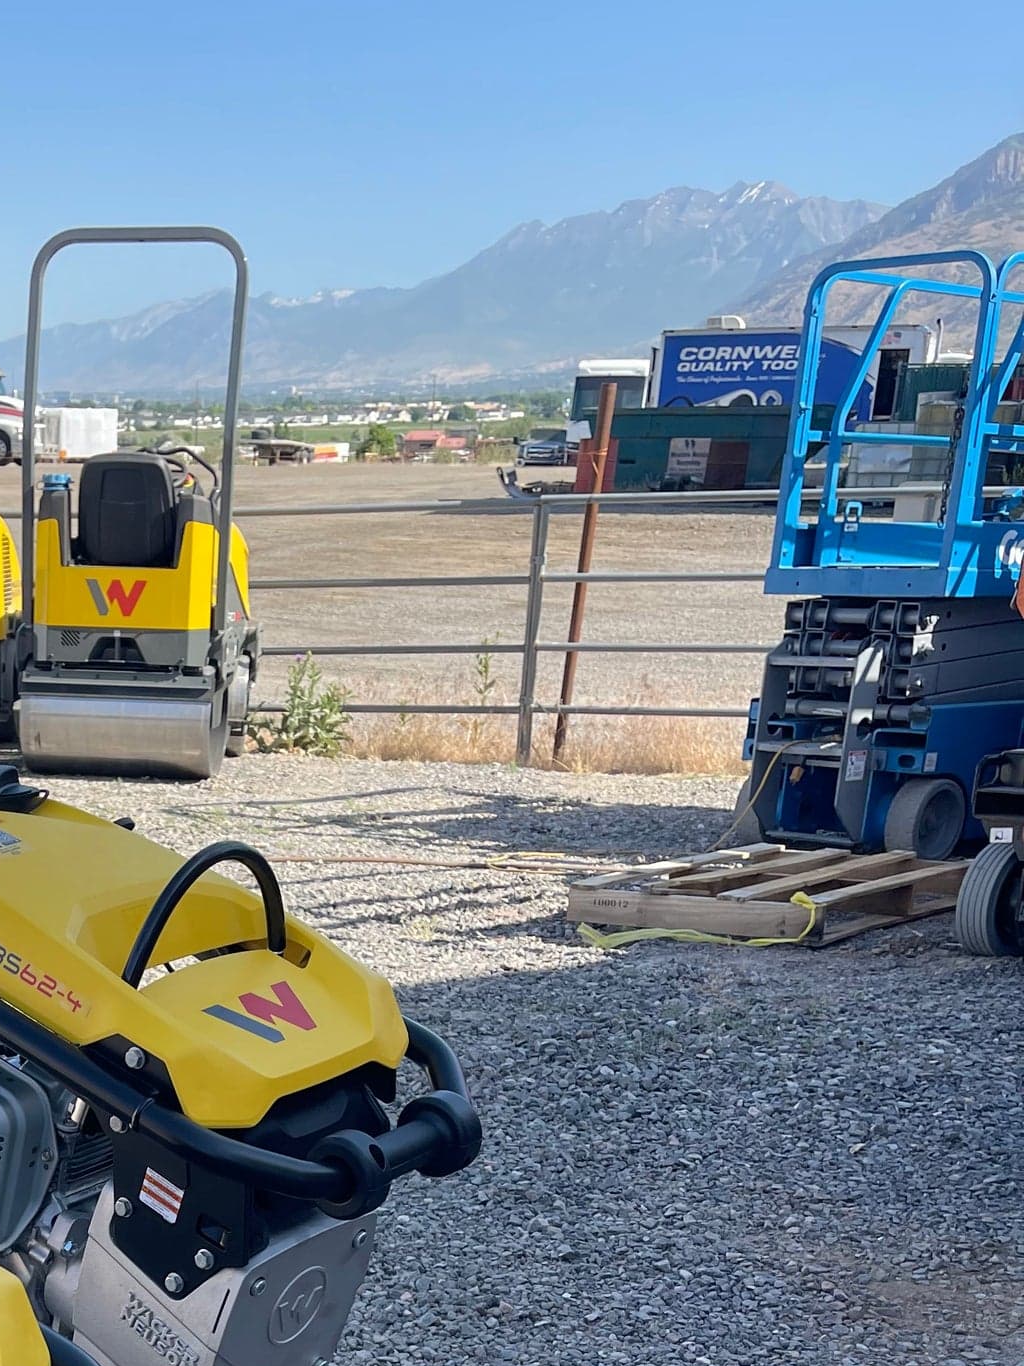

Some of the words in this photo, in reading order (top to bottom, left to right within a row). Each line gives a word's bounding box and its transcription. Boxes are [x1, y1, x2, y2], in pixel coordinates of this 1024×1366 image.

[679, 345, 800, 361] CORNWE
[677, 361, 755, 372] QUALITY
[761, 359, 799, 371] TOO
[85, 578, 147, 616] W
